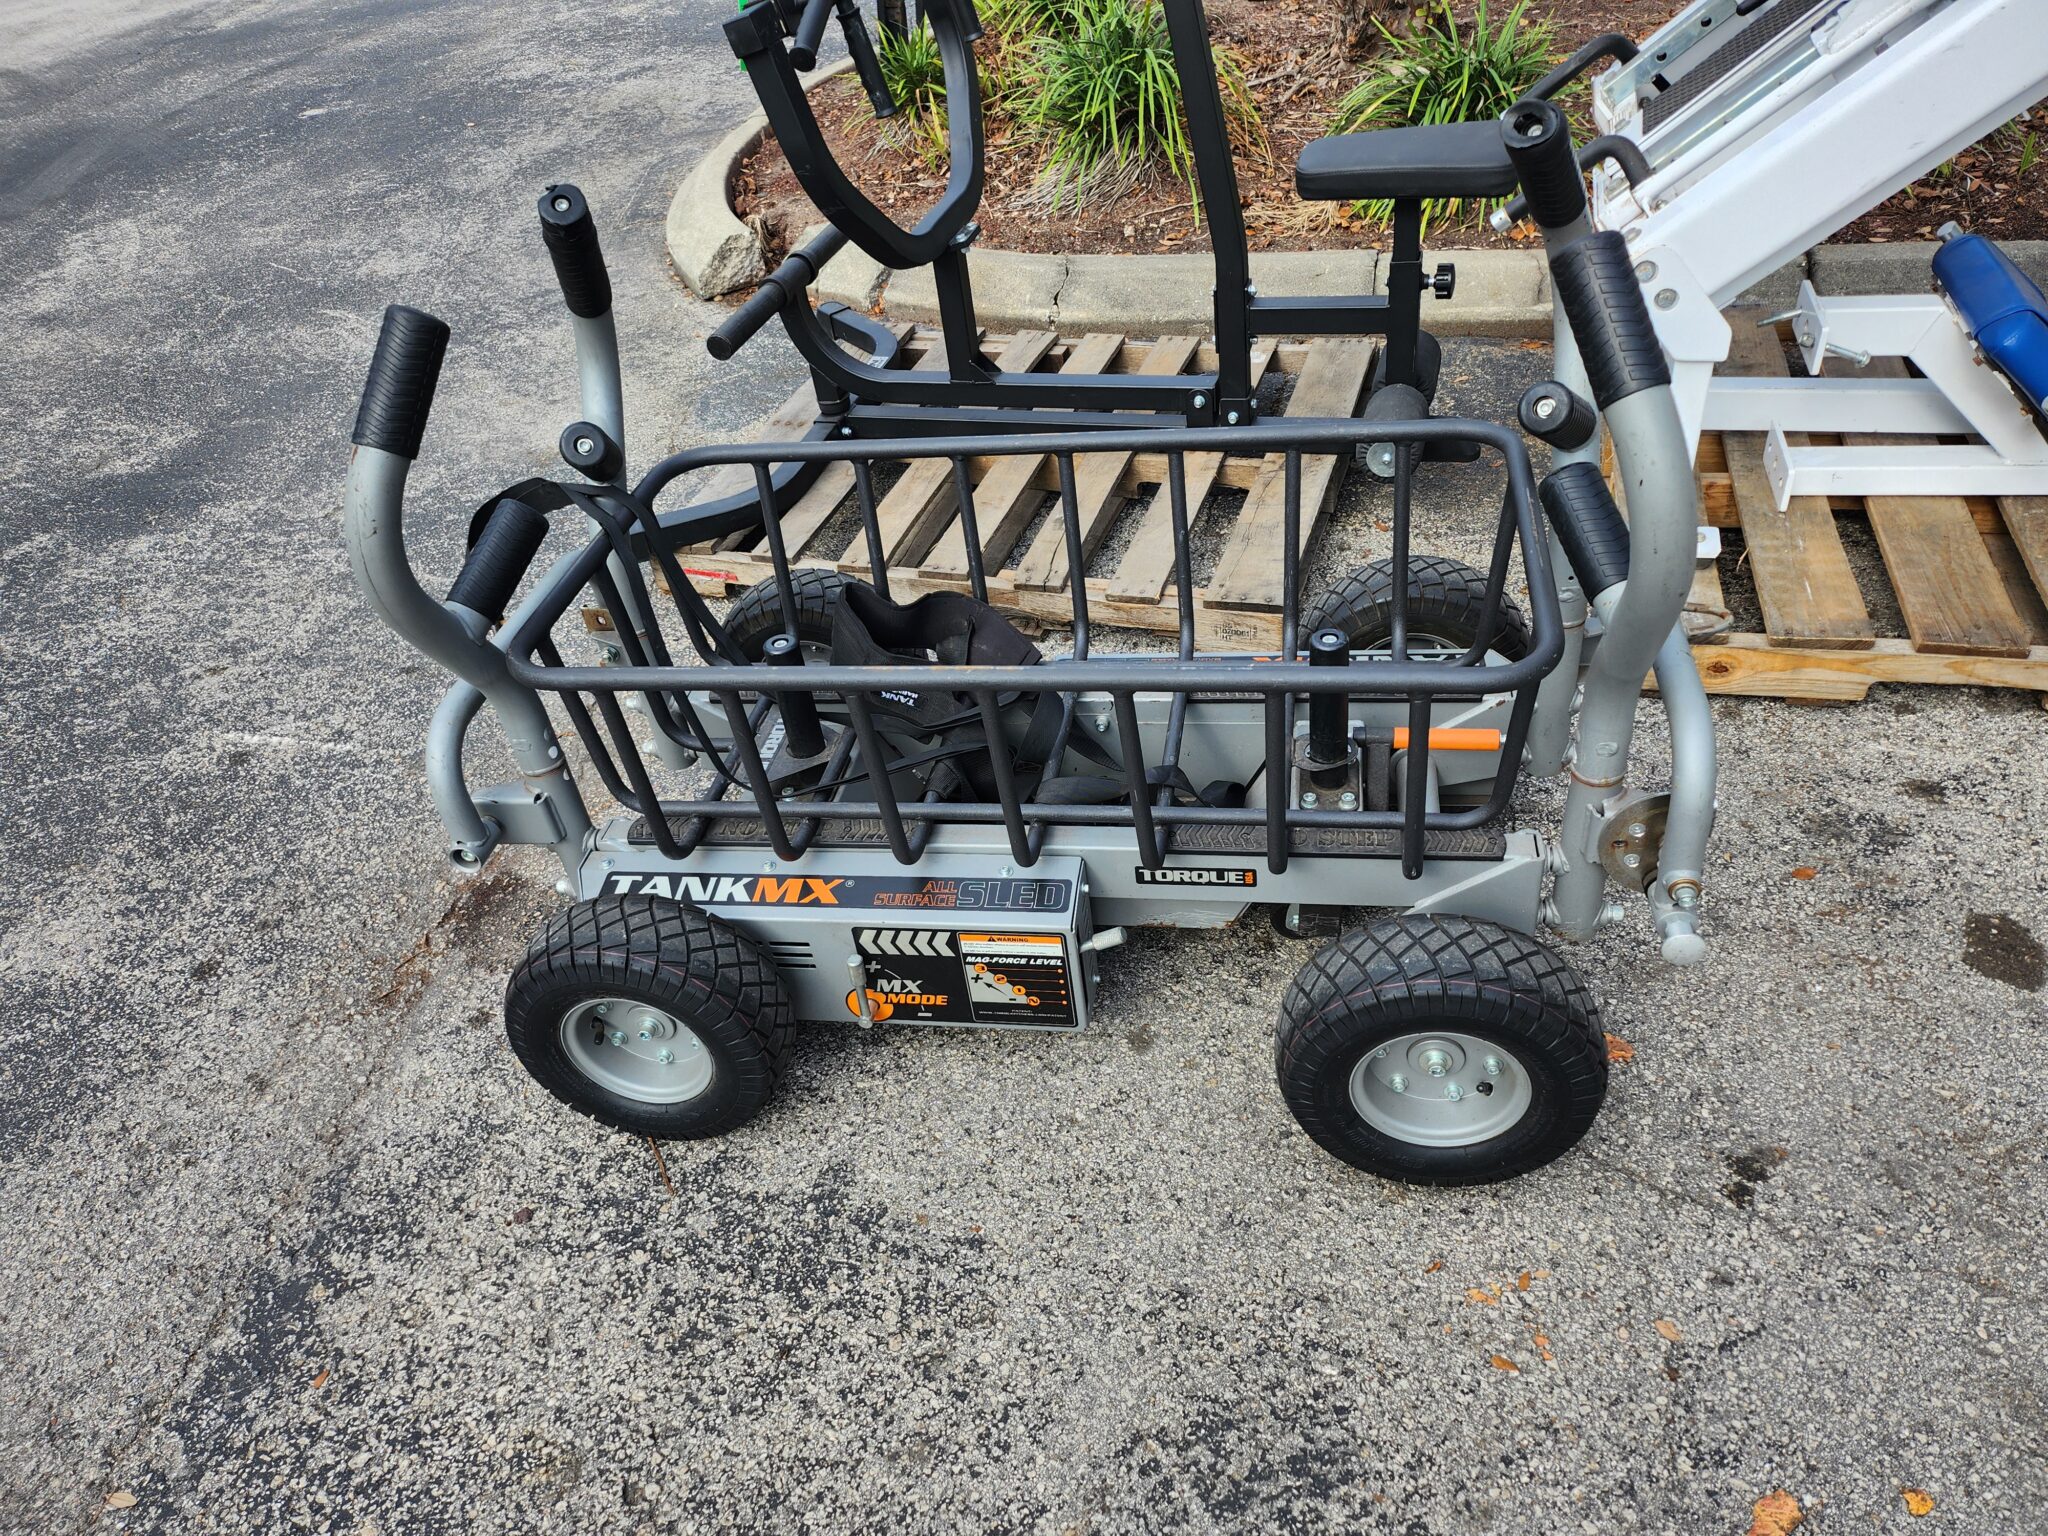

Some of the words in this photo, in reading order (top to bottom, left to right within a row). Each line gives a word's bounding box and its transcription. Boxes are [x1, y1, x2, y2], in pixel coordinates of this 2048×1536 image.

[881, 690, 915, 707] TANK
[1316, 829, 1395, 847] STEP
[1138, 869, 1244, 884] TORQUE
[922, 881, 958, 893] ALL
[873, 893, 957, 907] SURFACE
[956, 881, 1066, 909] SLED
[965, 956, 1027, 965] MAG-FORCE
[1029, 958, 1063, 966] LEVEL
[876, 978, 924, 994] MX
[887, 993, 949, 1006] MODE
